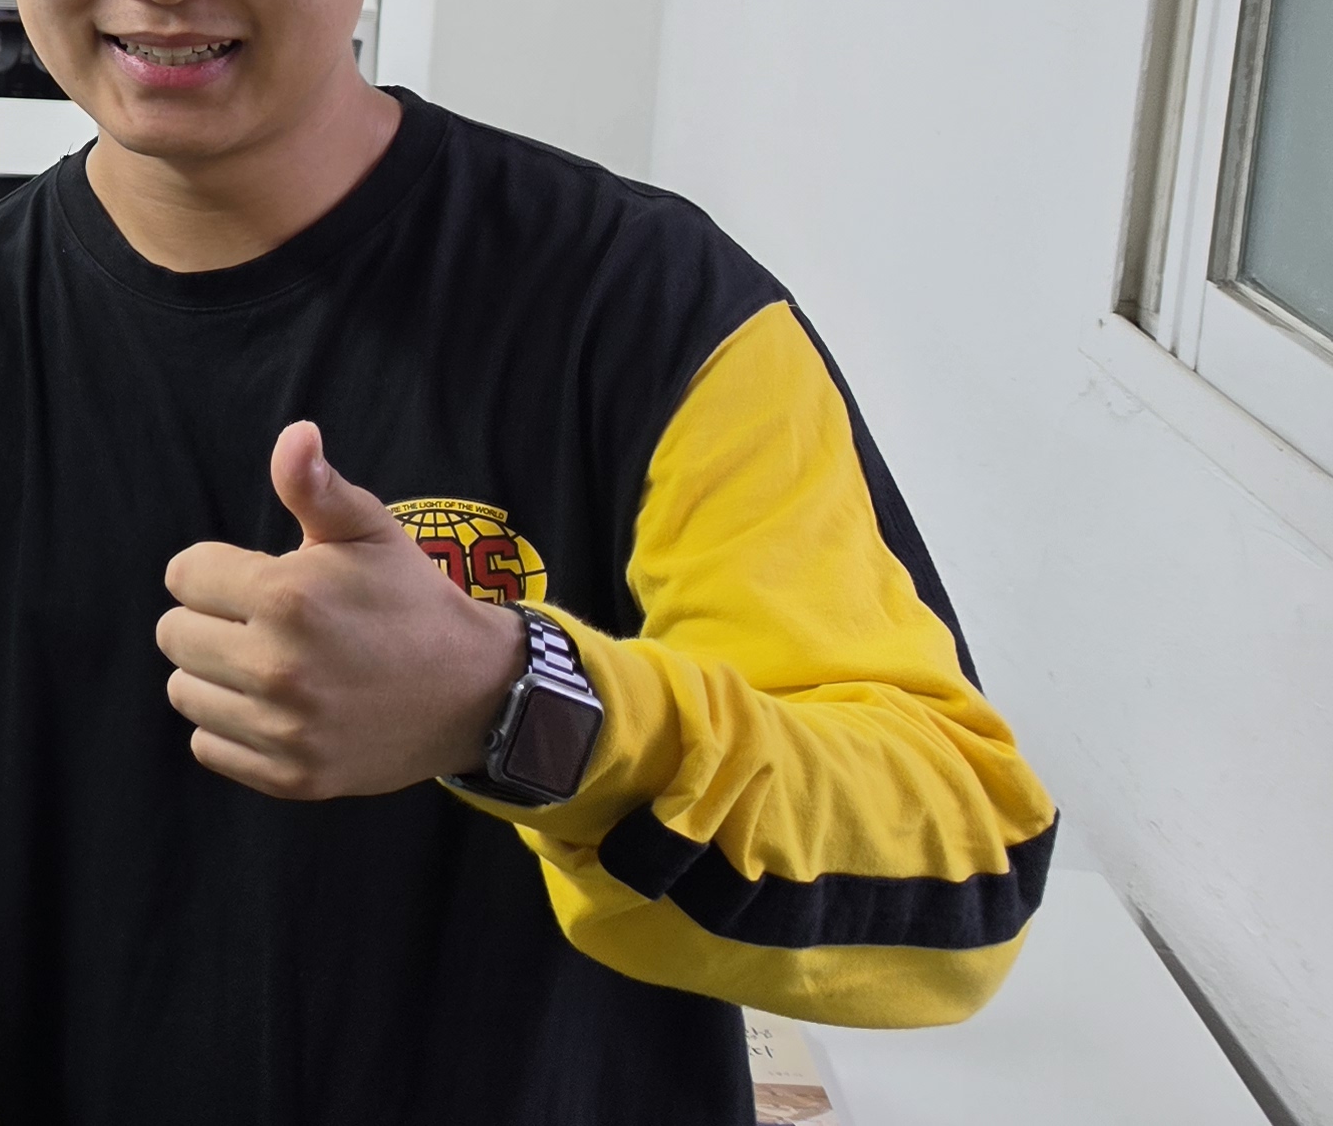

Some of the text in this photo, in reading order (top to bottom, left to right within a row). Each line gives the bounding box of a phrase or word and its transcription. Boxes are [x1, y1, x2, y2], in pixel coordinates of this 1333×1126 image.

[402, 503, 418, 512] THE
[419, 500, 442, 509] LIGHT
[445, 501, 455, 509] OF
[457, 503, 474, 512] THE
[475, 506, 505, 520] WORLD
